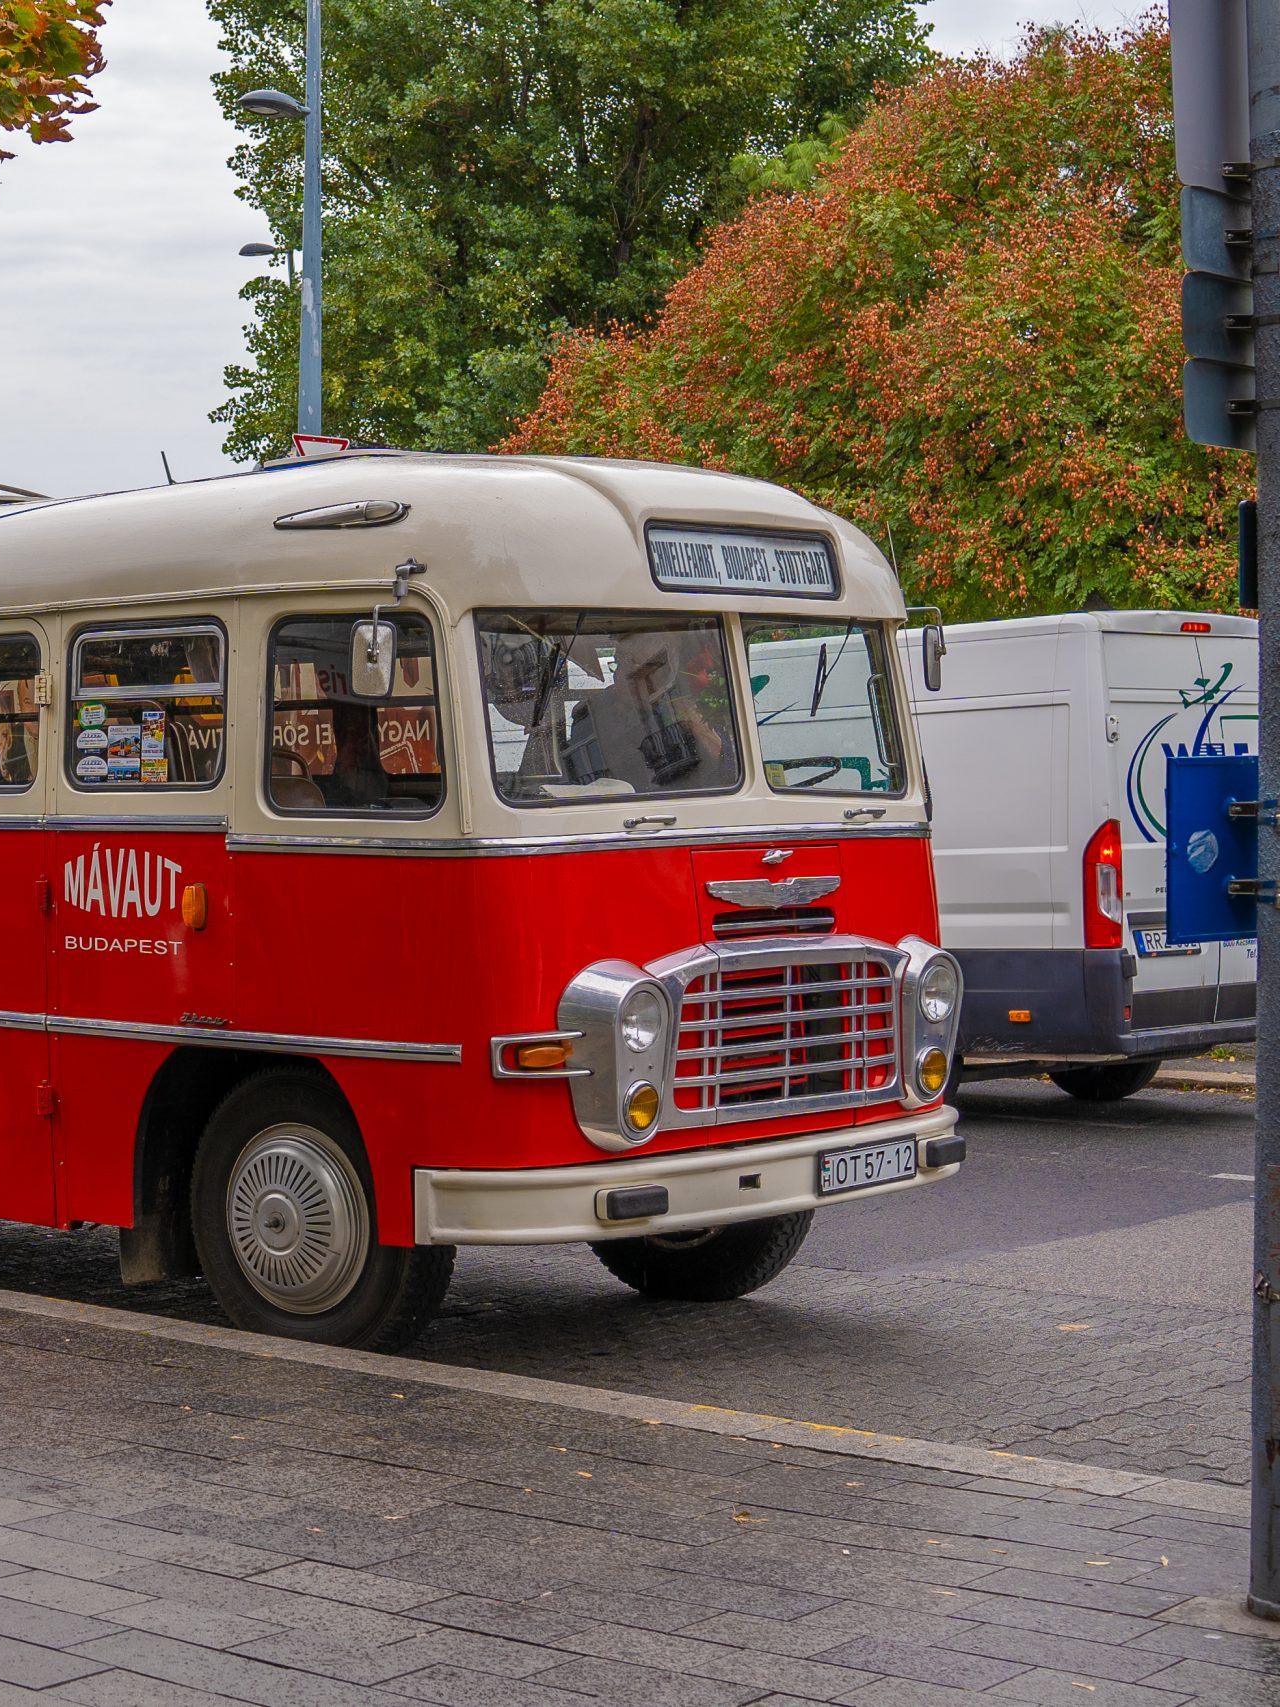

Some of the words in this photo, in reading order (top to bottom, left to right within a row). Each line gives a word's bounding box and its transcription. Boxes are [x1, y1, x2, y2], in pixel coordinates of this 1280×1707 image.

[721, 545, 770, 582] BUDAPEST
[775, 548, 830, 585] STUTTGART
[64, 842, 182, 918] MÁVAUT
[65, 935, 183, 955] BUDAPEST
